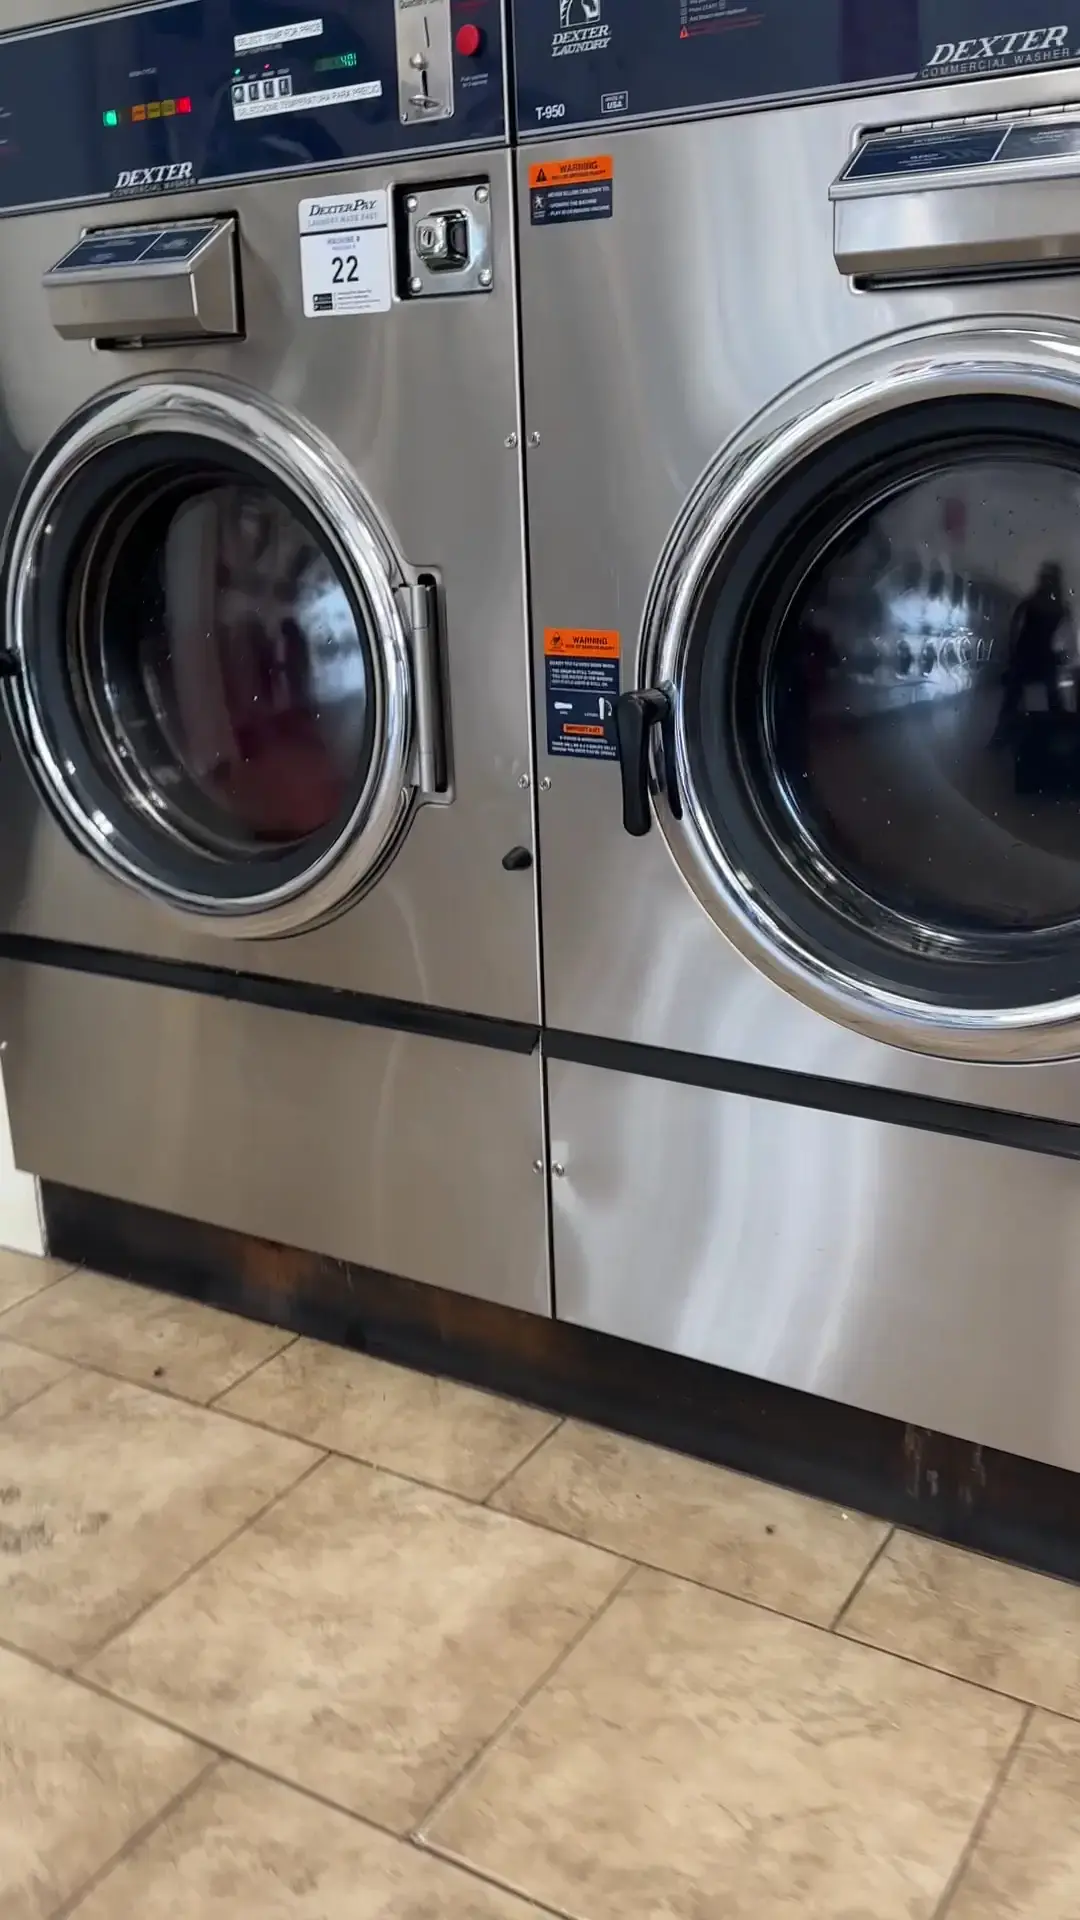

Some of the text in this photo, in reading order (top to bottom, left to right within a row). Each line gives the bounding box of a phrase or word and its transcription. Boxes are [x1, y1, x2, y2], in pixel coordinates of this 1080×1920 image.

[299, 23, 321, 37] PRICE
[551, 24, 609, 45] DEXTER
[551, 37, 612, 57] LAUNDRY
[926, 25, 1069, 66] DEXTER
[921, 48, 1070, 78] COMMERCIAL WASHER
[535, 103, 566, 121] T-950
[606, 100, 623, 110] USA
[115, 161, 193, 189] DEXTER
[560, 160, 598, 173] WARNING
[331, 254, 360, 284] 22
[573, 635, 609, 645] WARNING
